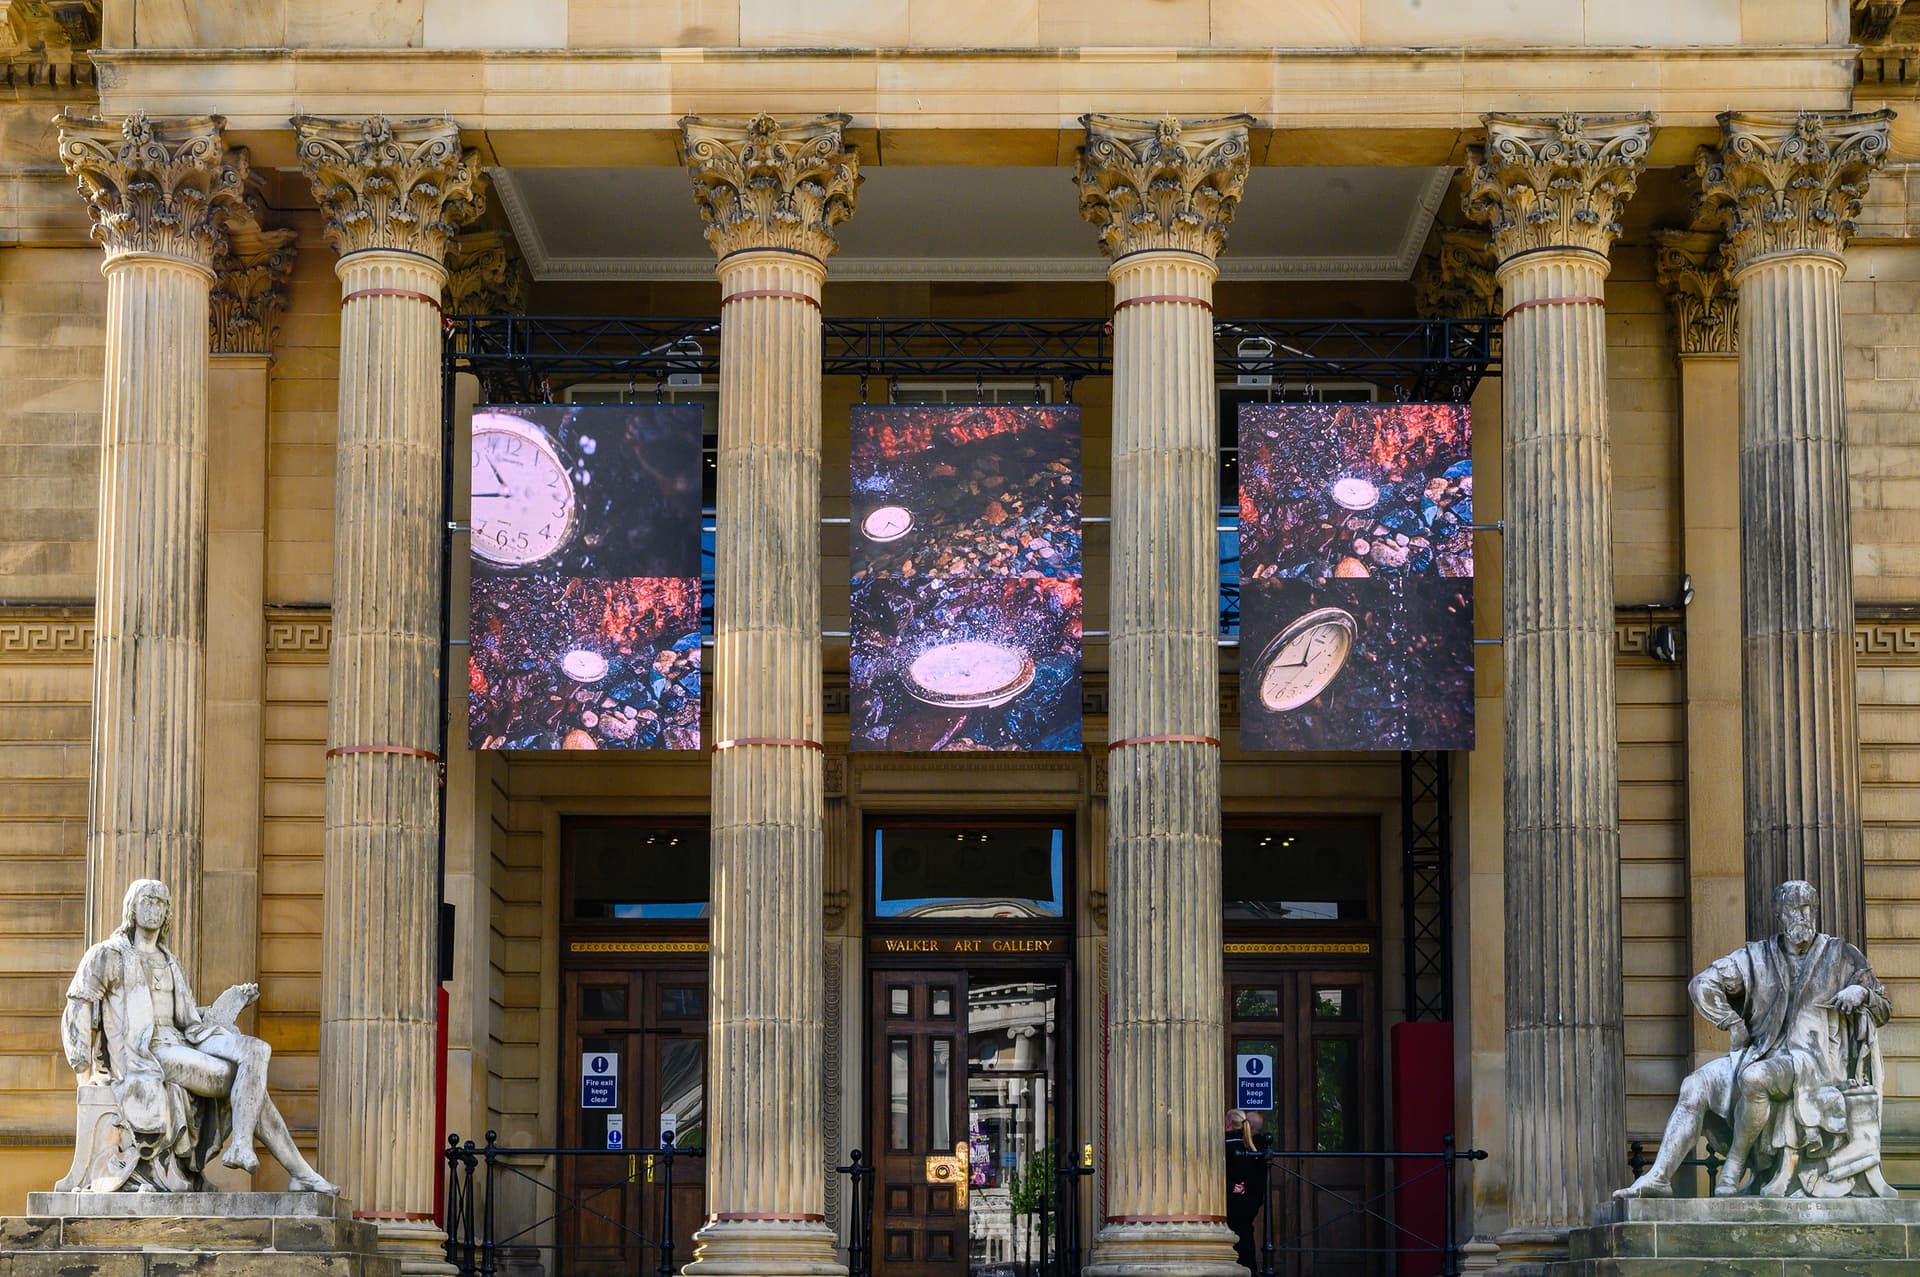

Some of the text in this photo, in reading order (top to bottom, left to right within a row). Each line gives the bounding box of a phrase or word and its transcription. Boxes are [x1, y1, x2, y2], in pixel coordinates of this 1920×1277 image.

[504, 437, 522, 456] 12
[546, 469, 560, 488] 2
[552, 494, 569, 518] 3
[496, 530, 508, 548] 6
[538, 523, 552, 540] 4
[516, 532, 529, 549] 5
[885, 939, 1053, 951] WALKER ART GALLERY
[591, 1087, 608, 1096] keep
[1241, 1080, 1269, 1088] Fire exit
[1246, 1090, 1263, 1098] keep
[1246, 1097, 1264, 1105] clear
